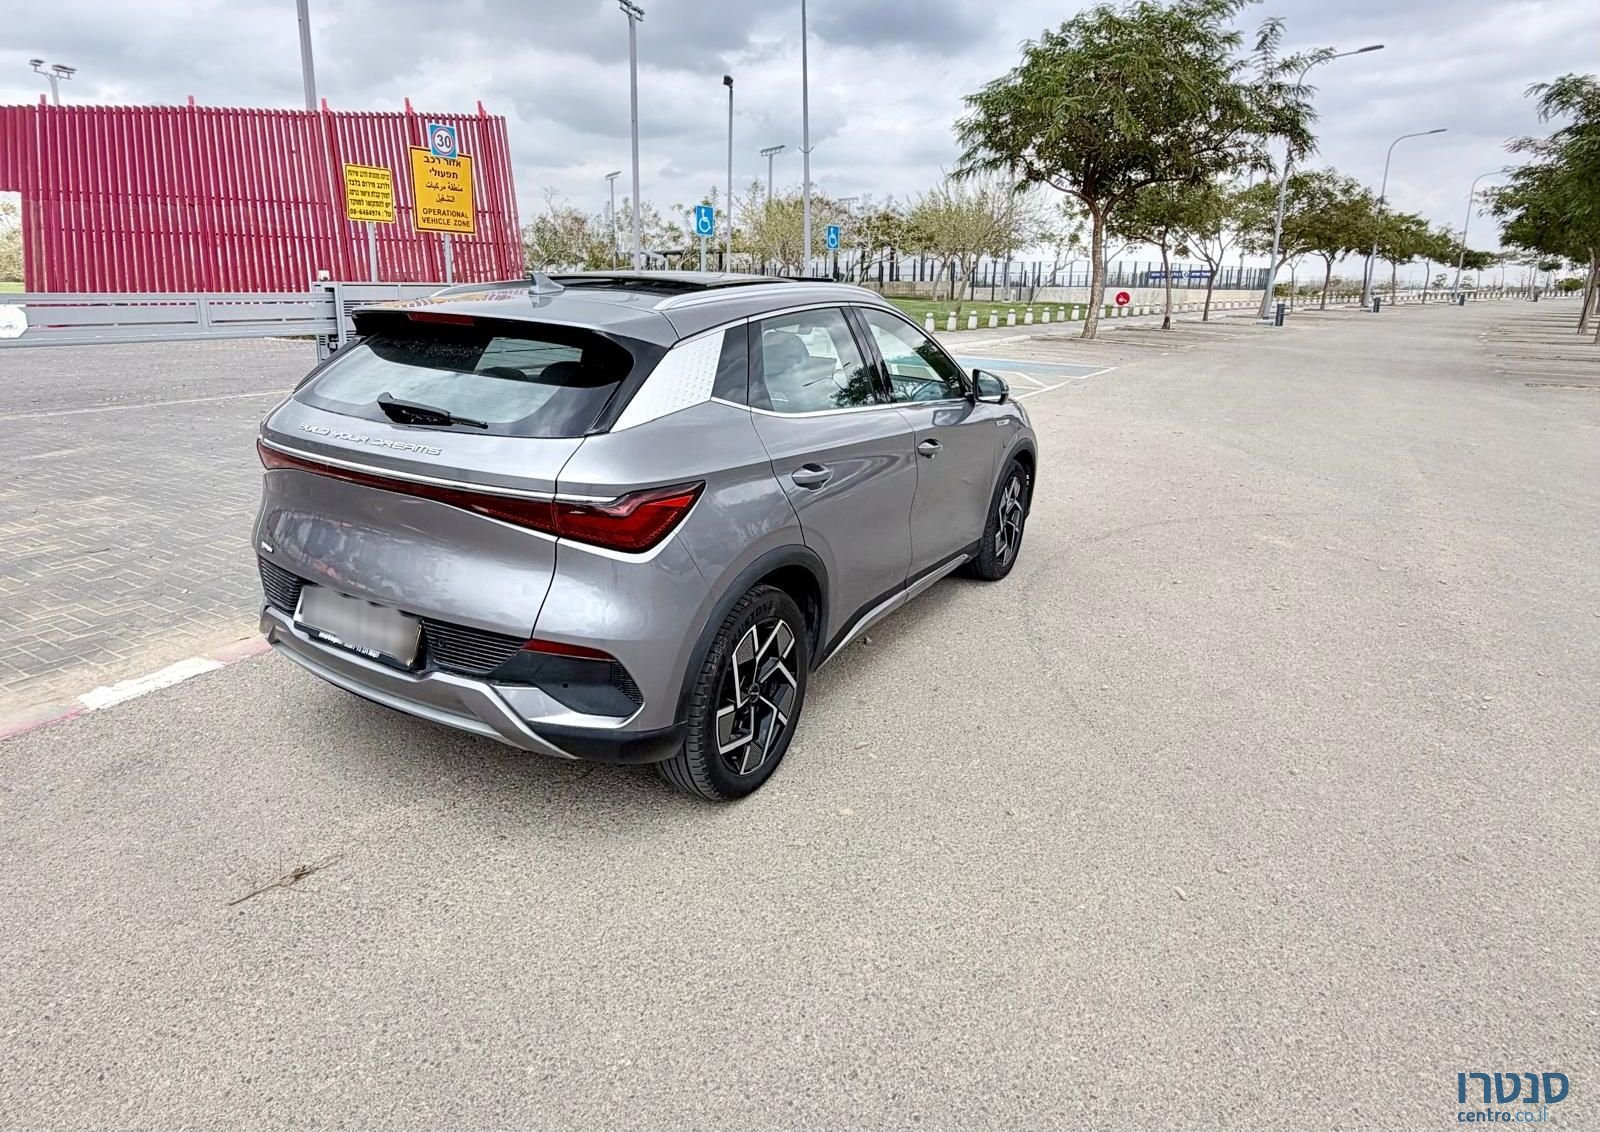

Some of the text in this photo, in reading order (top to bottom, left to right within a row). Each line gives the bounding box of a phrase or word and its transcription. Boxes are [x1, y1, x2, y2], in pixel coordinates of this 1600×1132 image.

[436, 134, 452, 149] 30
[423, 155, 441, 165] רכב
[429, 167, 459, 180] תפעולי
[347, 179, 361, 187] בלבד
[361, 180, 376, 189] חירום
[447, 182, 464, 193] منطقة
[422, 207, 469, 219] OPERATIONAL
[421, 216, 471, 228] VEHICLE ZONE
[298, 422, 443, 456] BUILD YOUR DREAMS
